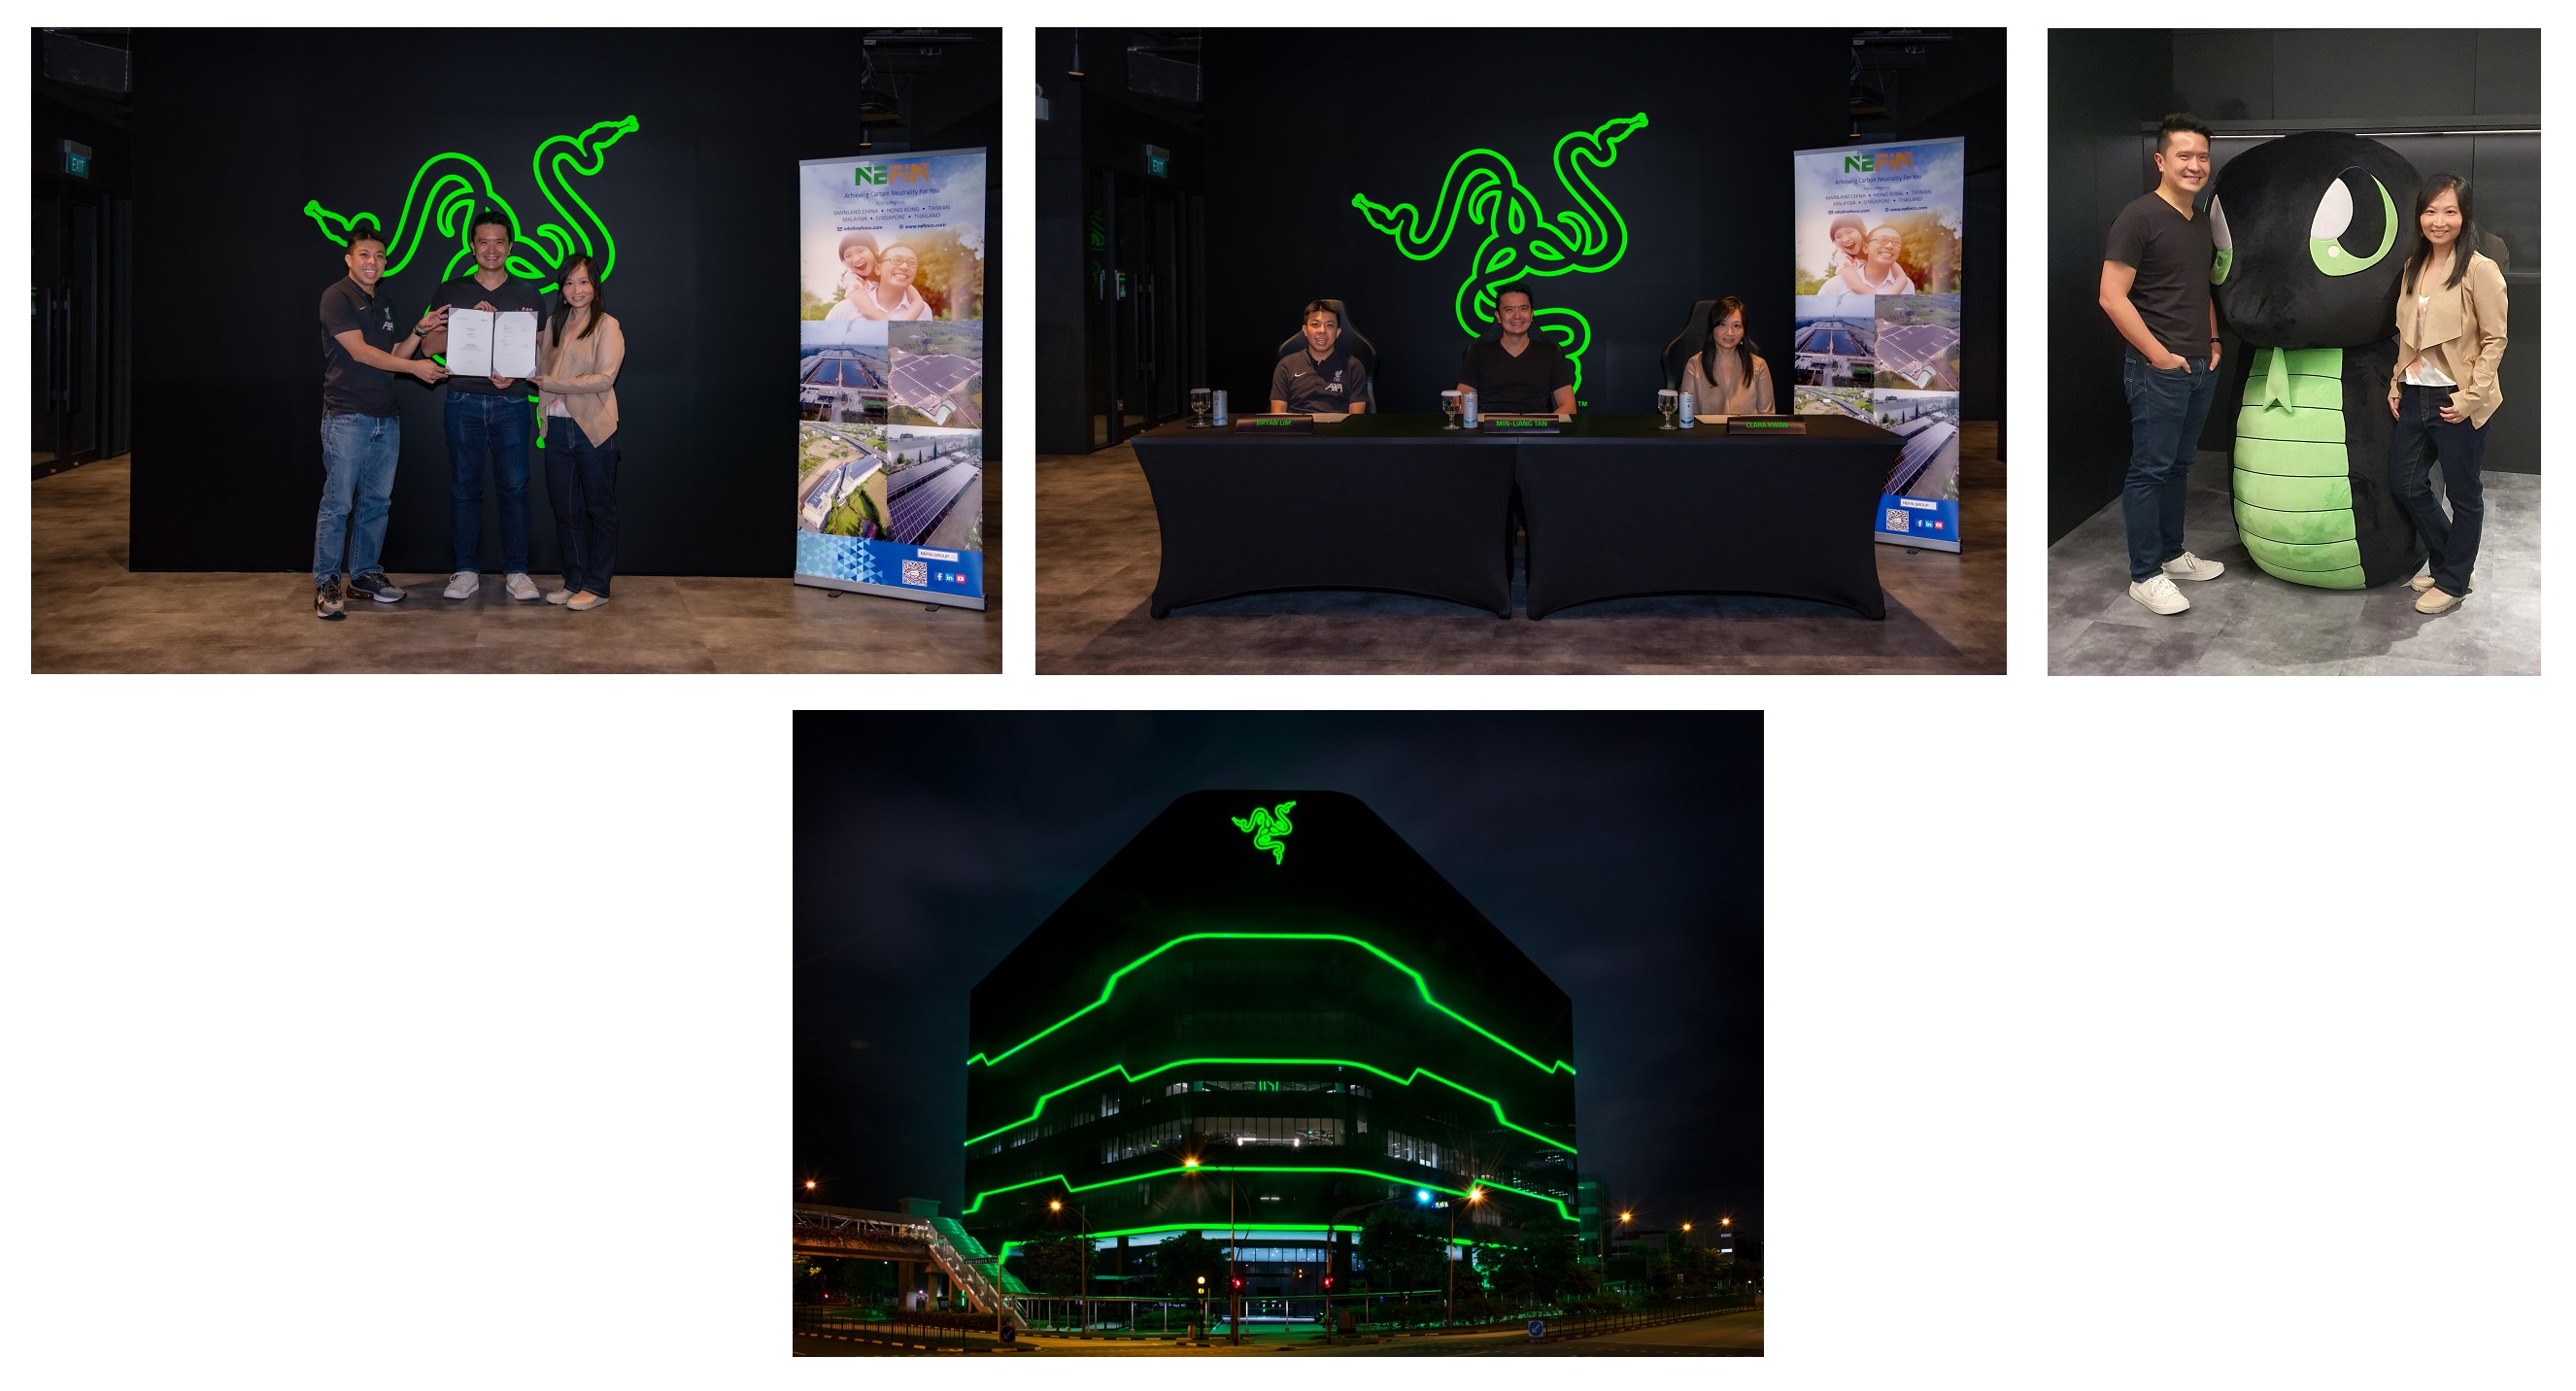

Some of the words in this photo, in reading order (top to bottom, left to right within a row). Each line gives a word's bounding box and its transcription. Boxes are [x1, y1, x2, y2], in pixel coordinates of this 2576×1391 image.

[71, 157, 85, 173] EXIT
[1152, 159, 1164, 174] EXIT
[1325, 382, 1343, 393] AXA
